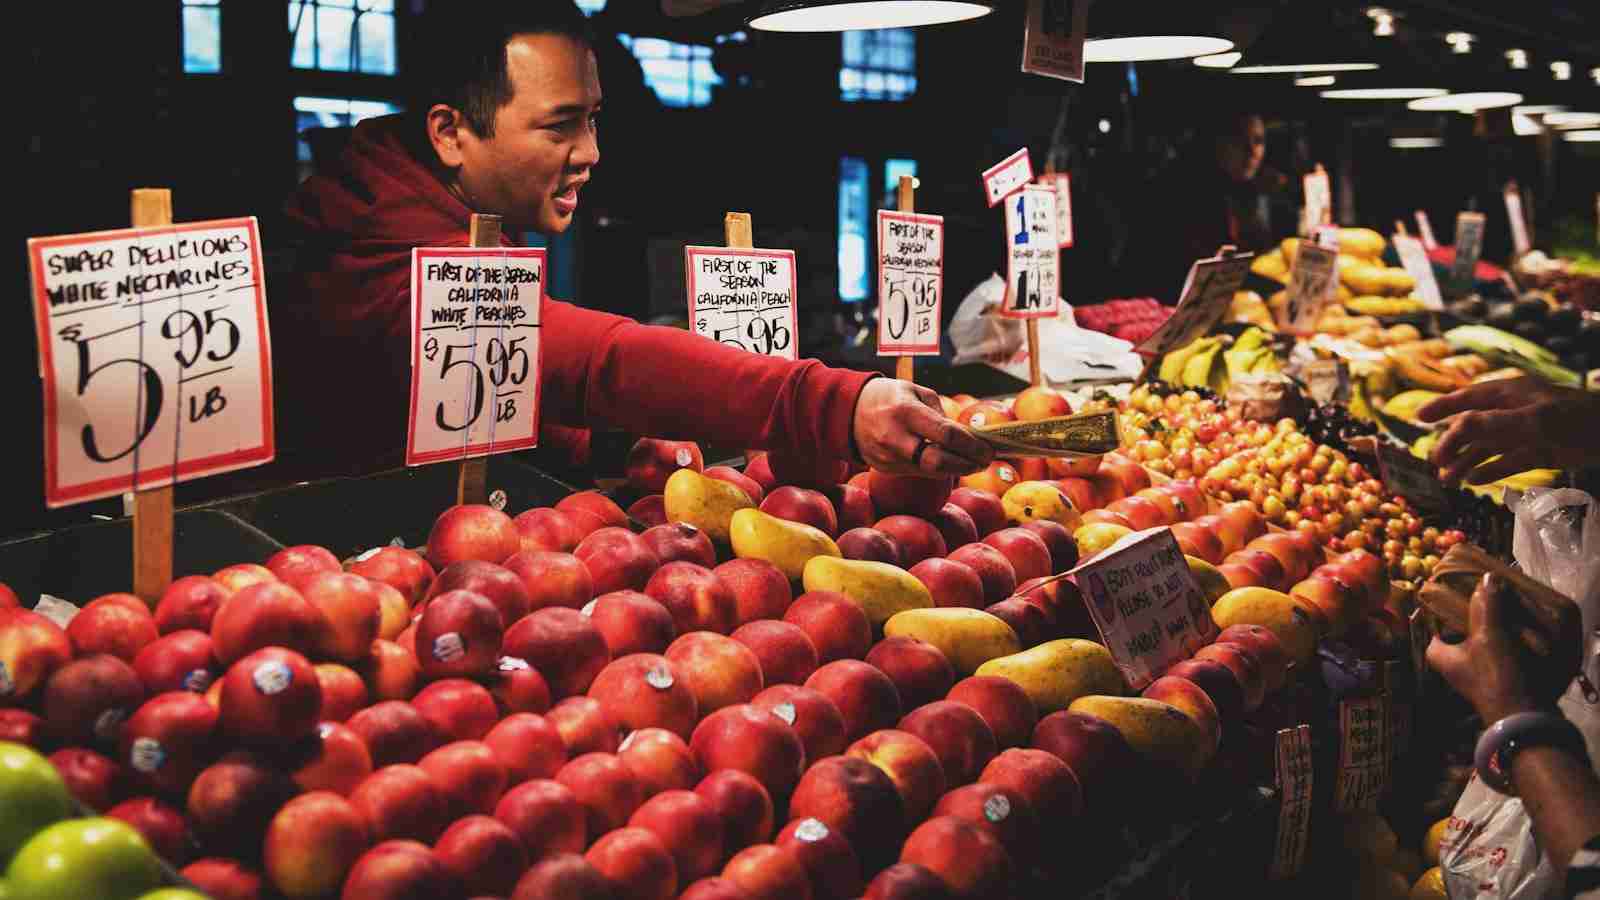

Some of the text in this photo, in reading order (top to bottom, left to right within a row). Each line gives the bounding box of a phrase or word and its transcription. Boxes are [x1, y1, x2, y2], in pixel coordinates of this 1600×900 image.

[47, 234, 249, 276] SUPER DELICIOUS
[427, 262, 463, 283] FIRST
[482, 267, 502, 284] THE
[702, 257, 777, 275] FIRST OF THE
[47, 260, 249, 307] WHITE NECTARINES
[720, 274, 765, 289] SEASON
[447, 285, 519, 302] CALIFORNIA
[697, 288, 791, 306] CALIFORNIA PEACH
[432, 305, 526, 323] WHITE PEACHES
[918, 317, 931, 335] LB
[189, 385, 228, 424] LB
[496, 399, 517, 423] LB
